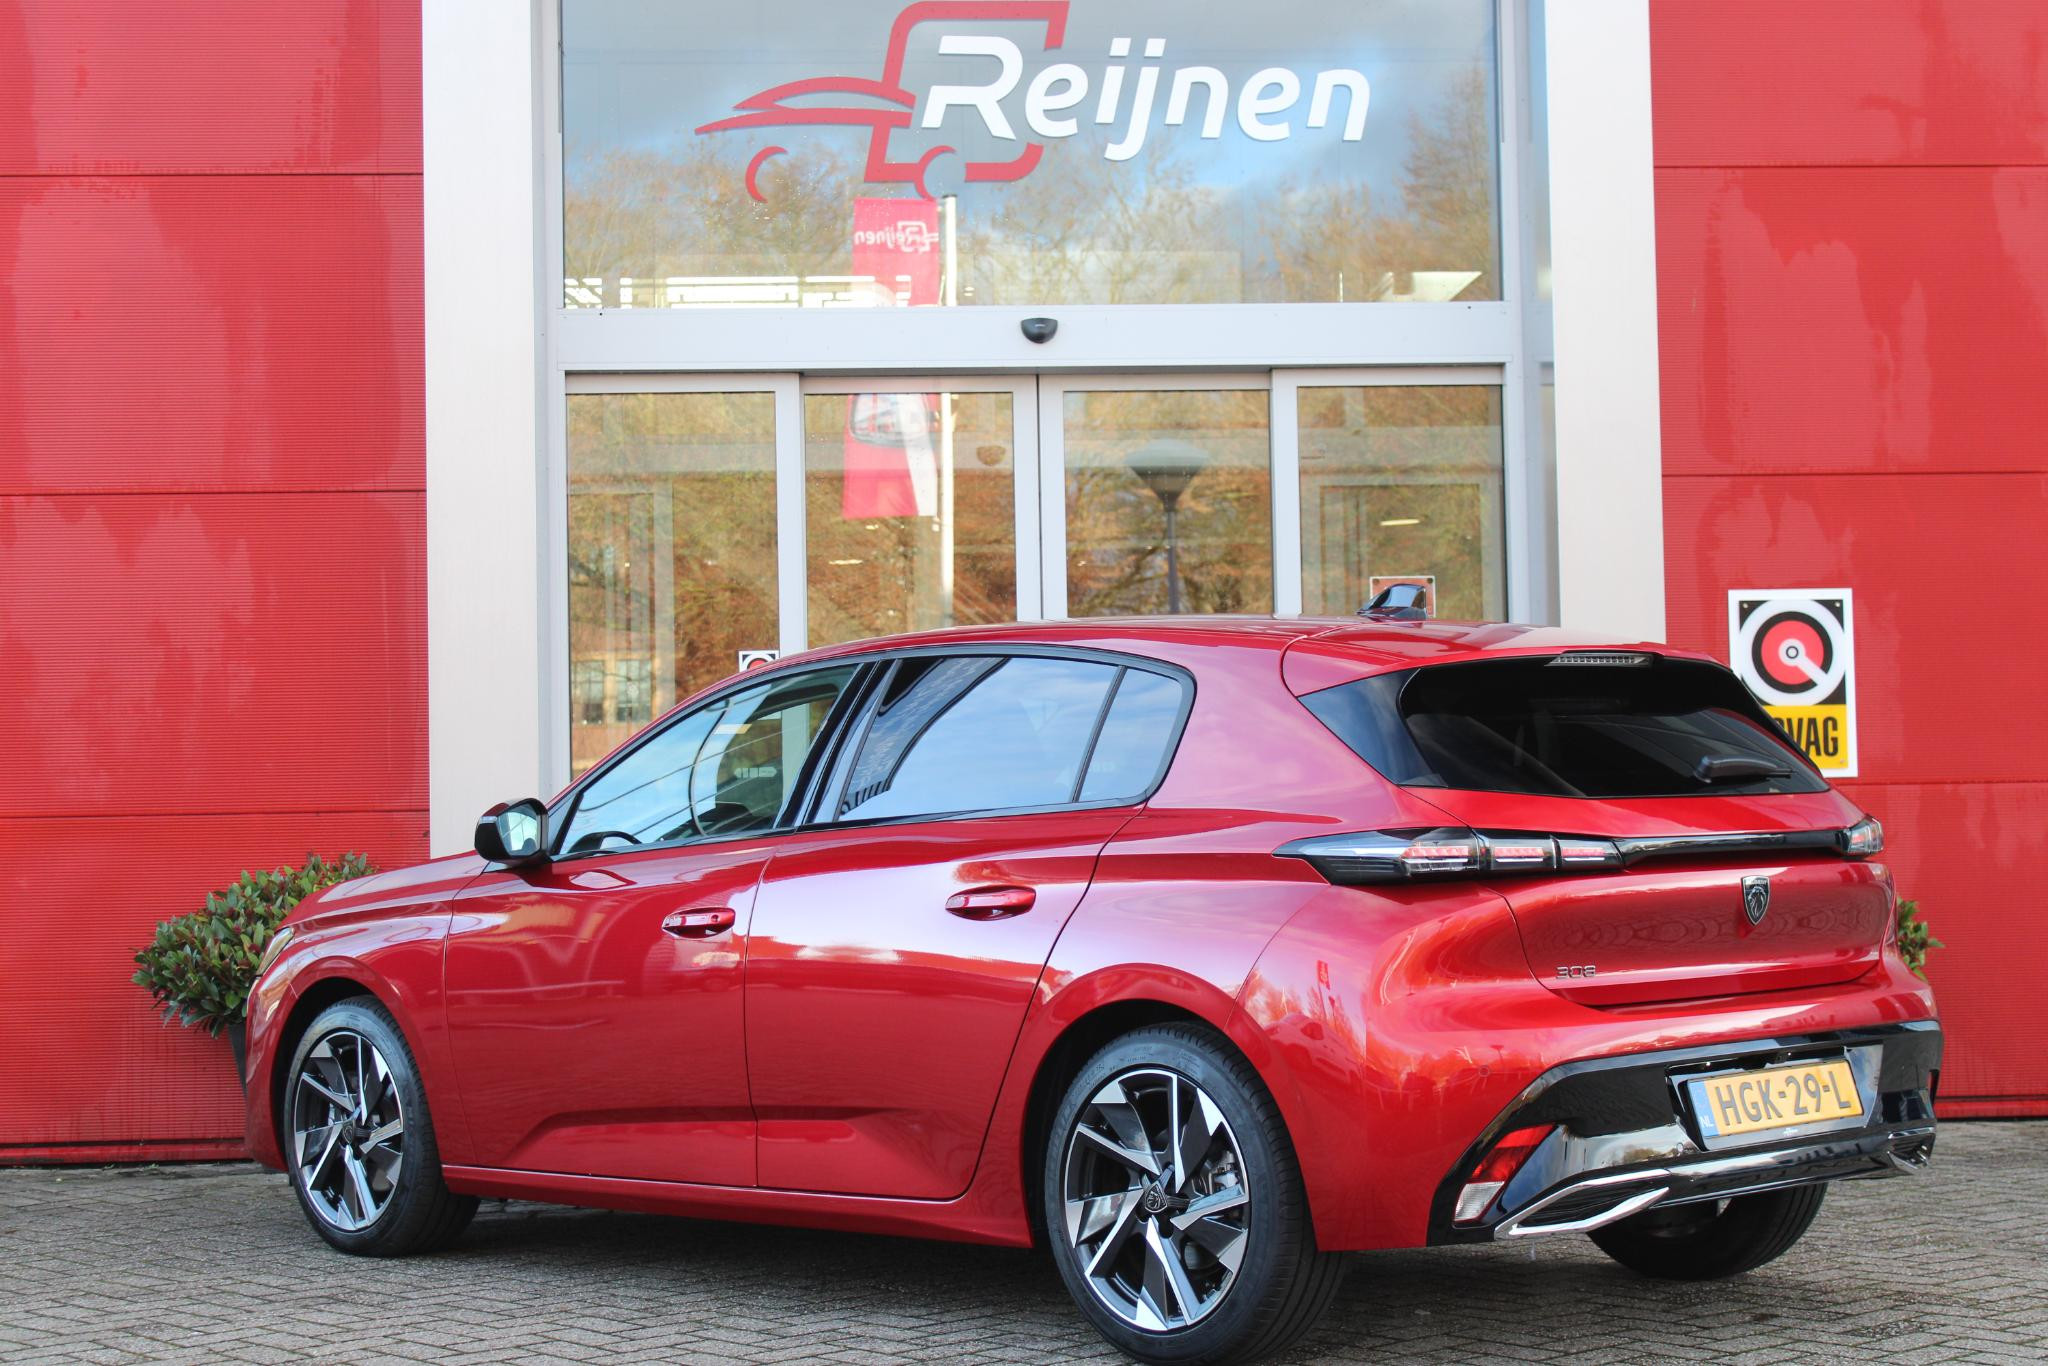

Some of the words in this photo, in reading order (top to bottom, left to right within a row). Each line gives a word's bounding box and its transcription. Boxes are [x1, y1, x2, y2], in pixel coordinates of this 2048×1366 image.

[921, 35, 1371, 161] Reijnen
[1773, 716, 1839, 757] VAG
[1556, 965, 1596, 979] 308
[1715, 1070, 1852, 1126] HGK-29-L
[1699, 1115, 1714, 1128] NL
